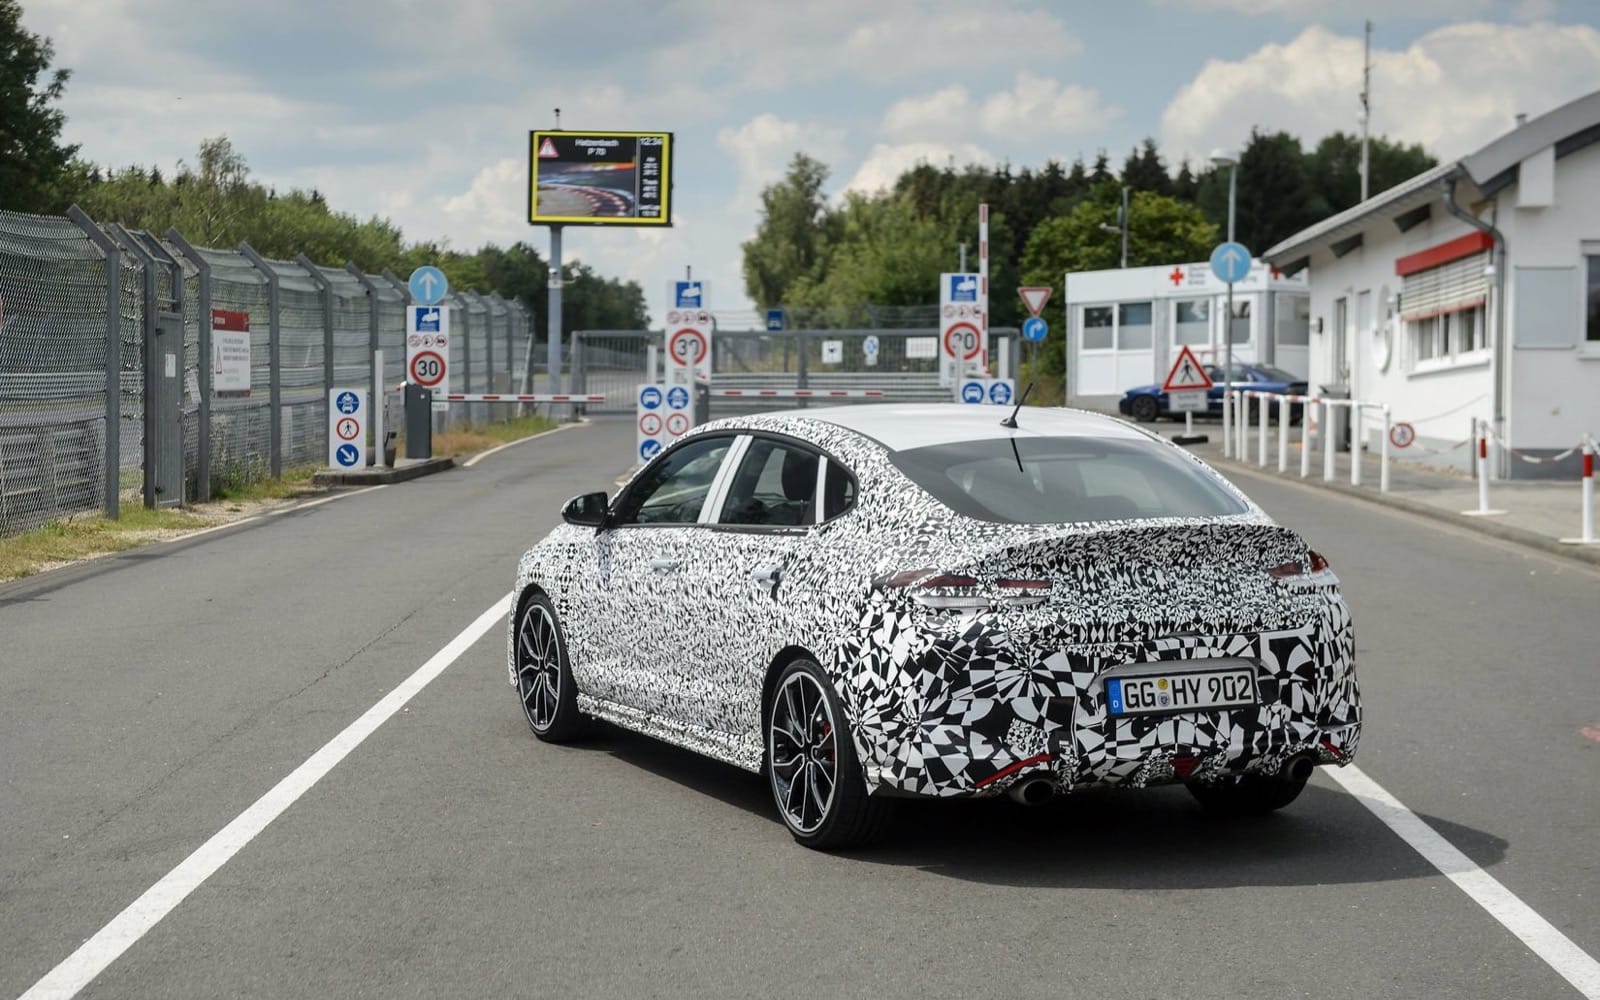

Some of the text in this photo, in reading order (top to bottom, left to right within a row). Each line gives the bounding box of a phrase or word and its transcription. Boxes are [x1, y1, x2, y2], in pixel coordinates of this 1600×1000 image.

[417, 360, 439, 377] 30
[1124, 681, 1156, 709] GG
[1172, 678, 1201, 705] HY
[1208, 675, 1252, 703] 902
